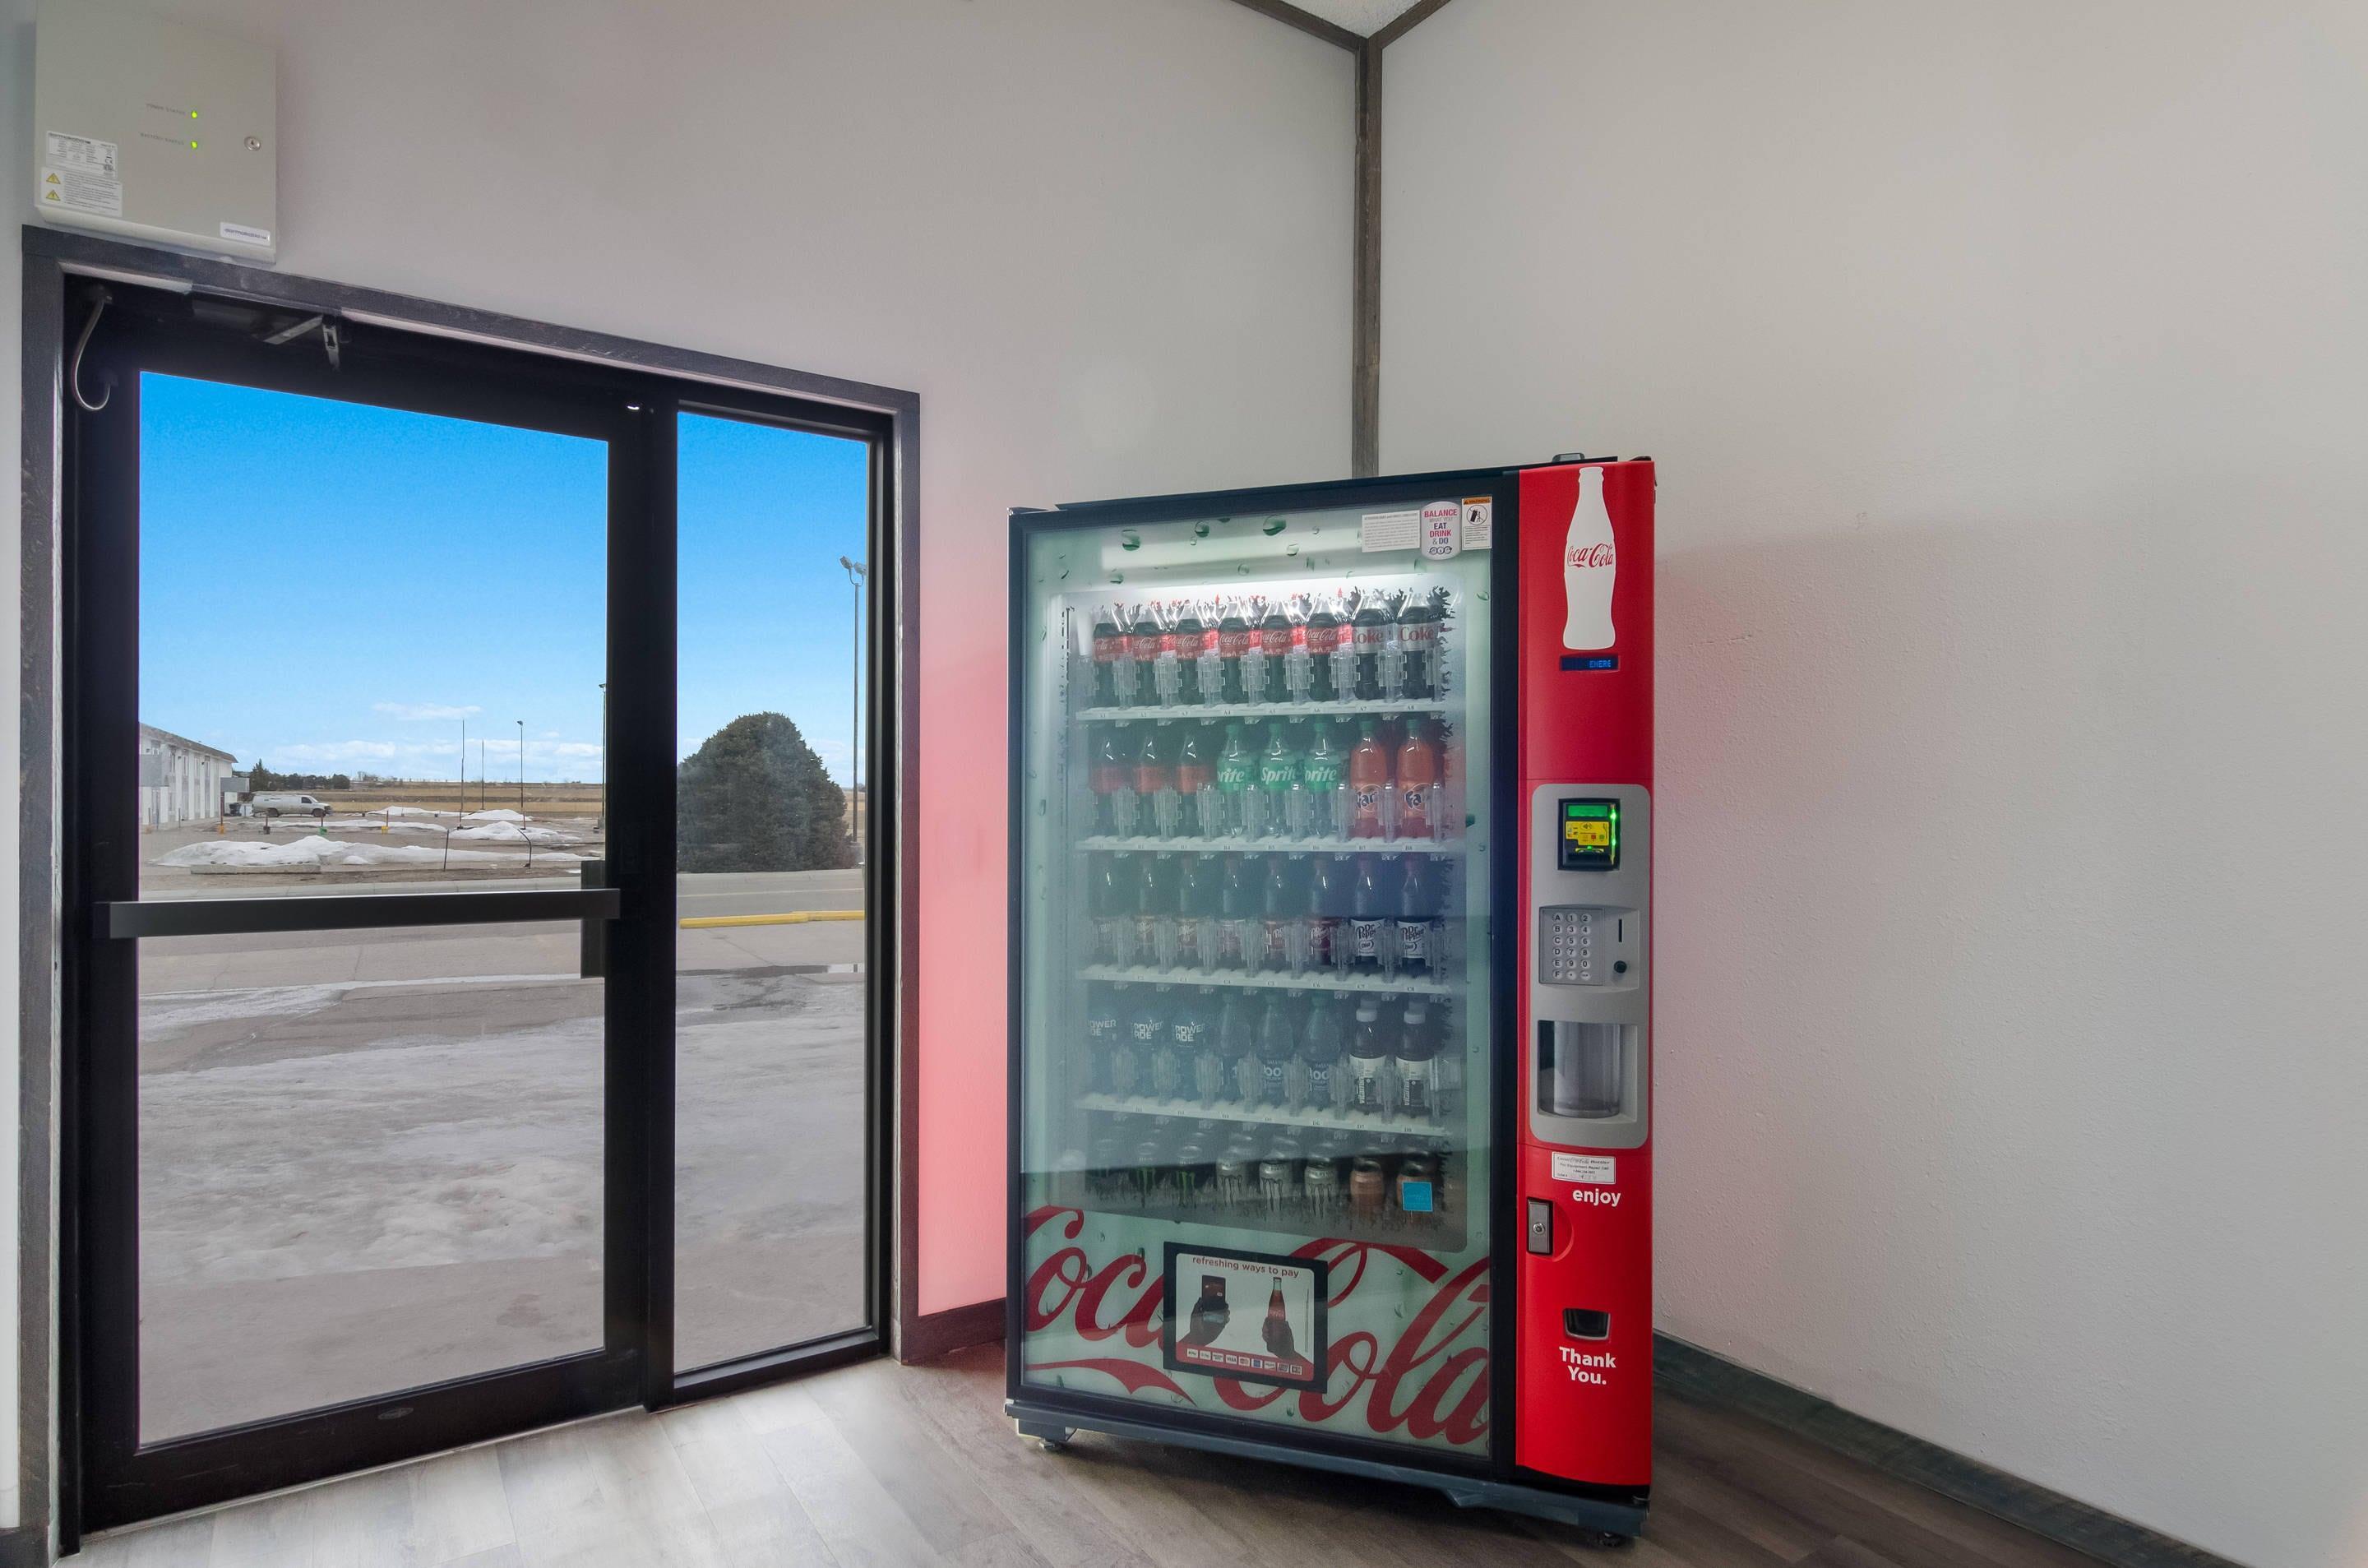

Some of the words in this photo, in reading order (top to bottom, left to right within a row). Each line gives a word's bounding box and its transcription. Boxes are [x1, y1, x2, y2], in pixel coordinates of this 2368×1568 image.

[1424, 509, 1458, 518] BALANCE
[1429, 530, 1451, 538] DRINK
[1566, 543, 1614, 568] Coca-Cola
[1306, 628, 1337, 641] Coca-Cola
[1352, 628, 1383, 644] Coke
[1401, 627, 1434, 641] Coke
[1358, 926, 1376, 940] Pepp
[1089, 1020, 1117, 1028] OWER
[1134, 1020, 1163, 1032] POWER
[1175, 1023, 1205, 1034] POWER
[1091, 1028, 1102, 1036] DE
[1134, 1031, 1152, 1039] ADE
[1176, 1034, 1194, 1042] ADE
[1572, 1188, 1621, 1207] enjoy
[1192, 1256, 1239, 1270] refreshing
[1242, 1264, 1265, 1273] ways
[1269, 1266, 1279, 1274] to
[1281, 1269, 1299, 1278] pay
[1559, 1346, 1616, 1368] Thank
[1567, 1365, 1607, 1385] You.
